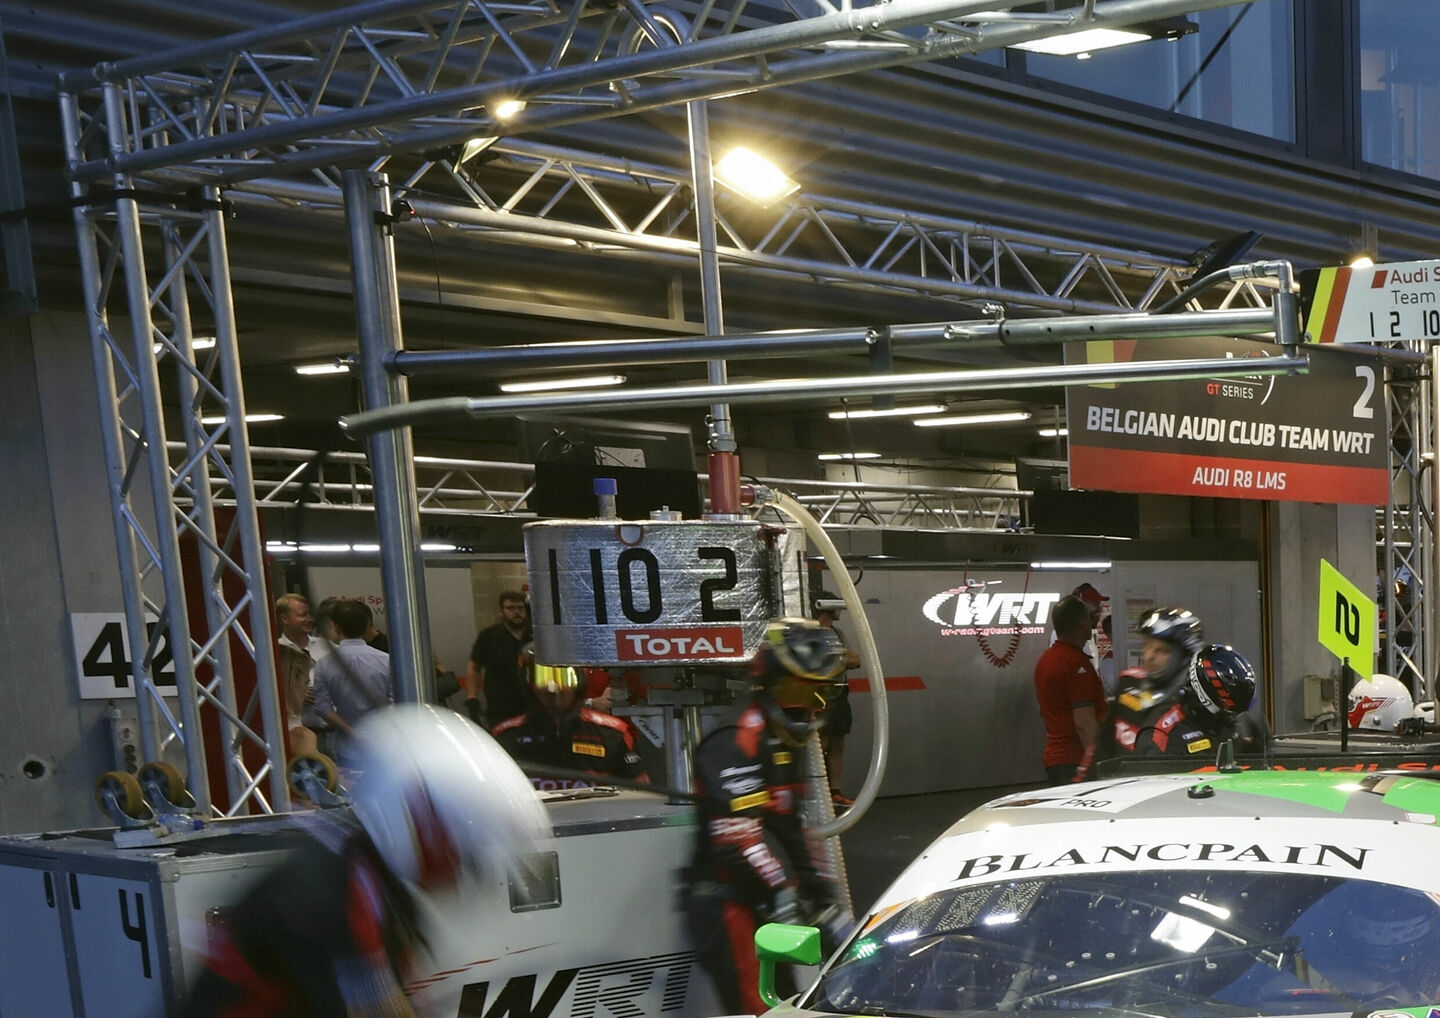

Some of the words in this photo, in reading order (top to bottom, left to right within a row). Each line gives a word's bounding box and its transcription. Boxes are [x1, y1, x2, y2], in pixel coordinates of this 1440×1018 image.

[1390, 267, 1429, 285] Audi
[1391, 290, 1436, 305] Team
[1369, 311, 1375, 337] 1
[1389, 311, 1401, 337] 2
[1423, 309, 1440, 336] 10
[1206, 383, 1220, 396] GT
[1222, 385, 1254, 400] SERIES
[1353, 365, 1376, 419] 2
[1086, 405, 1176, 439] BELGIAN
[1177, 416, 1225, 443] AUDI
[1228, 420, 1276, 447] CLUB
[1279, 425, 1328, 451] TEAM
[1333, 430, 1375, 454] WRT
[1192, 466, 1229, 487] AUDI
[1233, 469, 1252, 488] R8
[1256, 470, 1286, 490] LMS
[698, 547, 741, 622] 2
[953, 593, 1060, 625] WRT
[83, 622, 177, 688] 42
[626, 634, 734, 656] TOTAL
[1061, 799, 1112, 809] PRO
[954, 842, 1373, 883] BLANCPAIN
